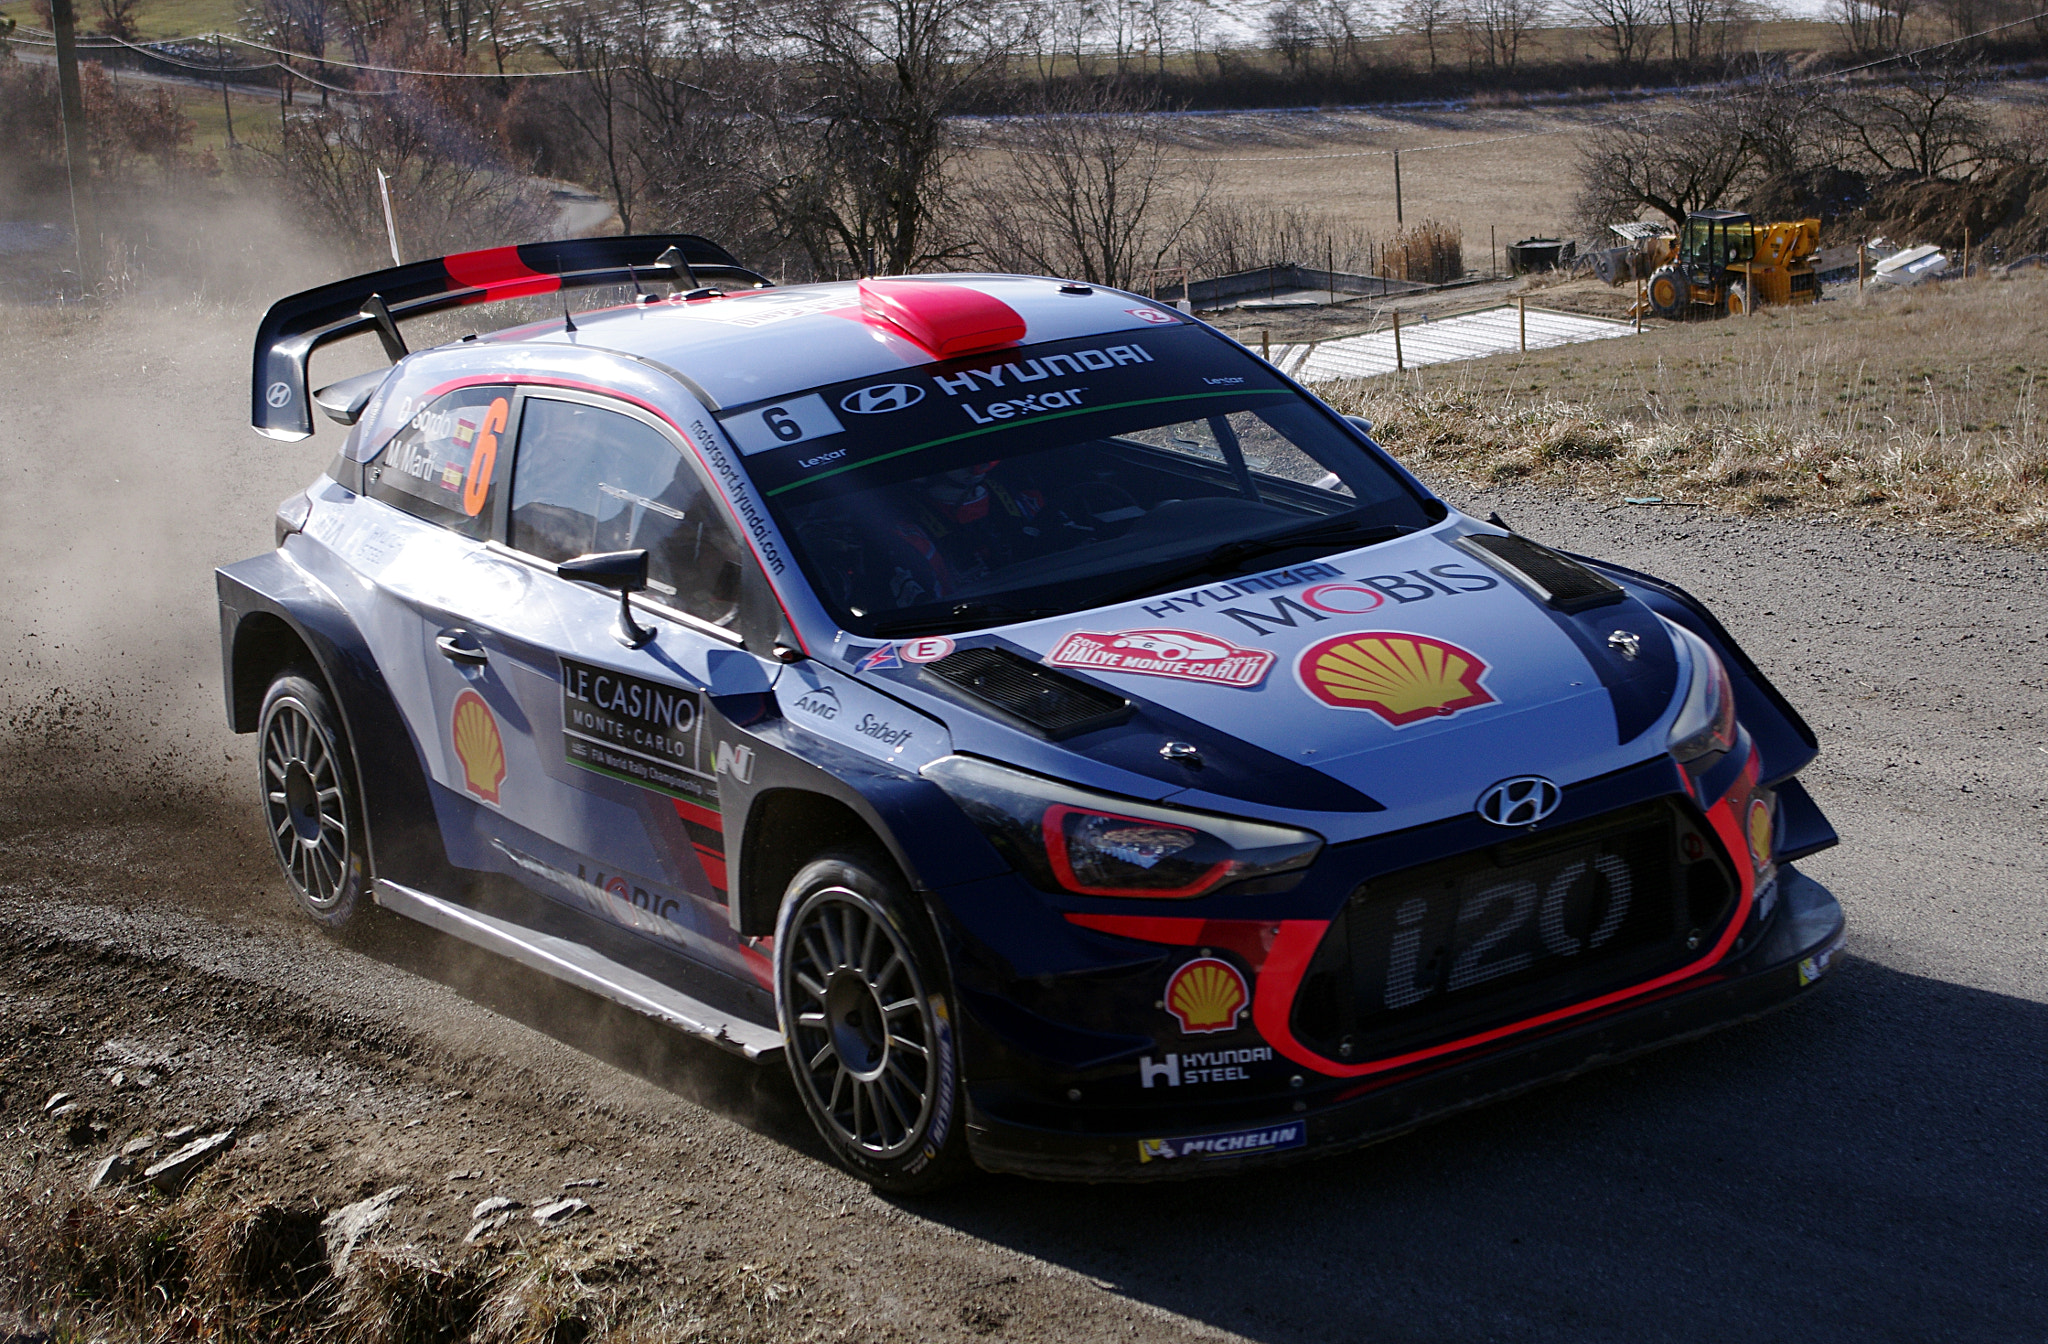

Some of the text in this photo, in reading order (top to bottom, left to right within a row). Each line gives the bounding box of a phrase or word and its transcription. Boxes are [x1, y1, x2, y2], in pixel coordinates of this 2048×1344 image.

[932, 344, 1155, 395] HYUNDAI
[1201, 375, 1246, 387] Lexar
[412, 401, 452, 439] Sordo
[961, 387, 1084, 424] Lexar
[762, 406, 803, 442] 6
[463, 397, 510, 517] 6
[798, 448, 848, 469] Lexar
[689, 419, 786, 576] motorsport.hyundai.com
[1141, 563, 1346, 619] HYUNDAI
[1217, 563, 1500, 637] MOBIS
[917, 641, 938, 658] E
[1071, 635, 1104, 650] 2017
[1055, 643, 1261, 683] RALLYE MONTE-CARLO
[1223, 655, 1265, 667] 2017
[566, 666, 695, 733] LE CASINO
[794, 696, 838, 720] AMG
[855, 713, 913, 747] Sabelt
[1383, 853, 1633, 1010] i20
[1183, 1047, 1273, 1067] HYUNDAI
[1184, 1066, 1250, 1085] STEEL
[1182, 1127, 1298, 1156] MICHELIN
